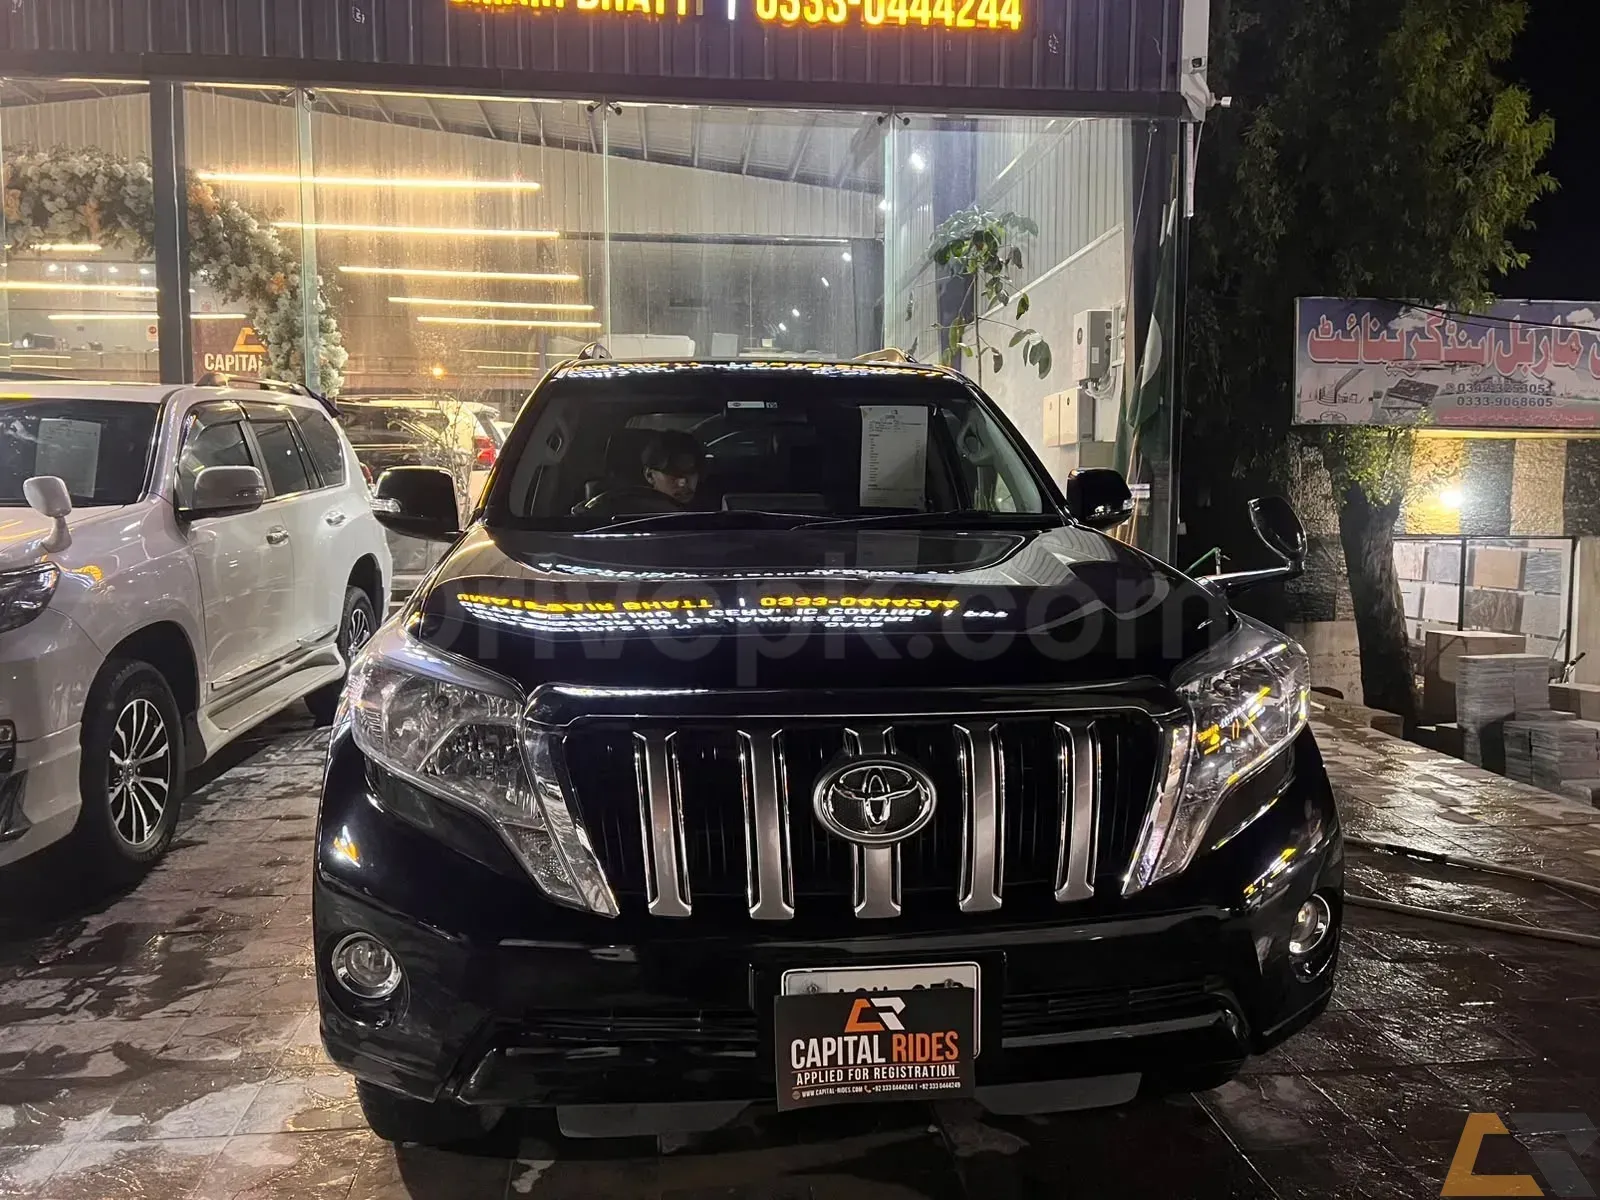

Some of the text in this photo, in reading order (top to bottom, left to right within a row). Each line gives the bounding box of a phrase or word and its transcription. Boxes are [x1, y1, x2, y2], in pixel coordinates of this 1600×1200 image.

[204, 353, 263, 372] CAPITA
[790, 1030, 959, 1069] CAPITAL RIDES
[796, 1064, 956, 1086] APPLIED FOR REGISTRATION
